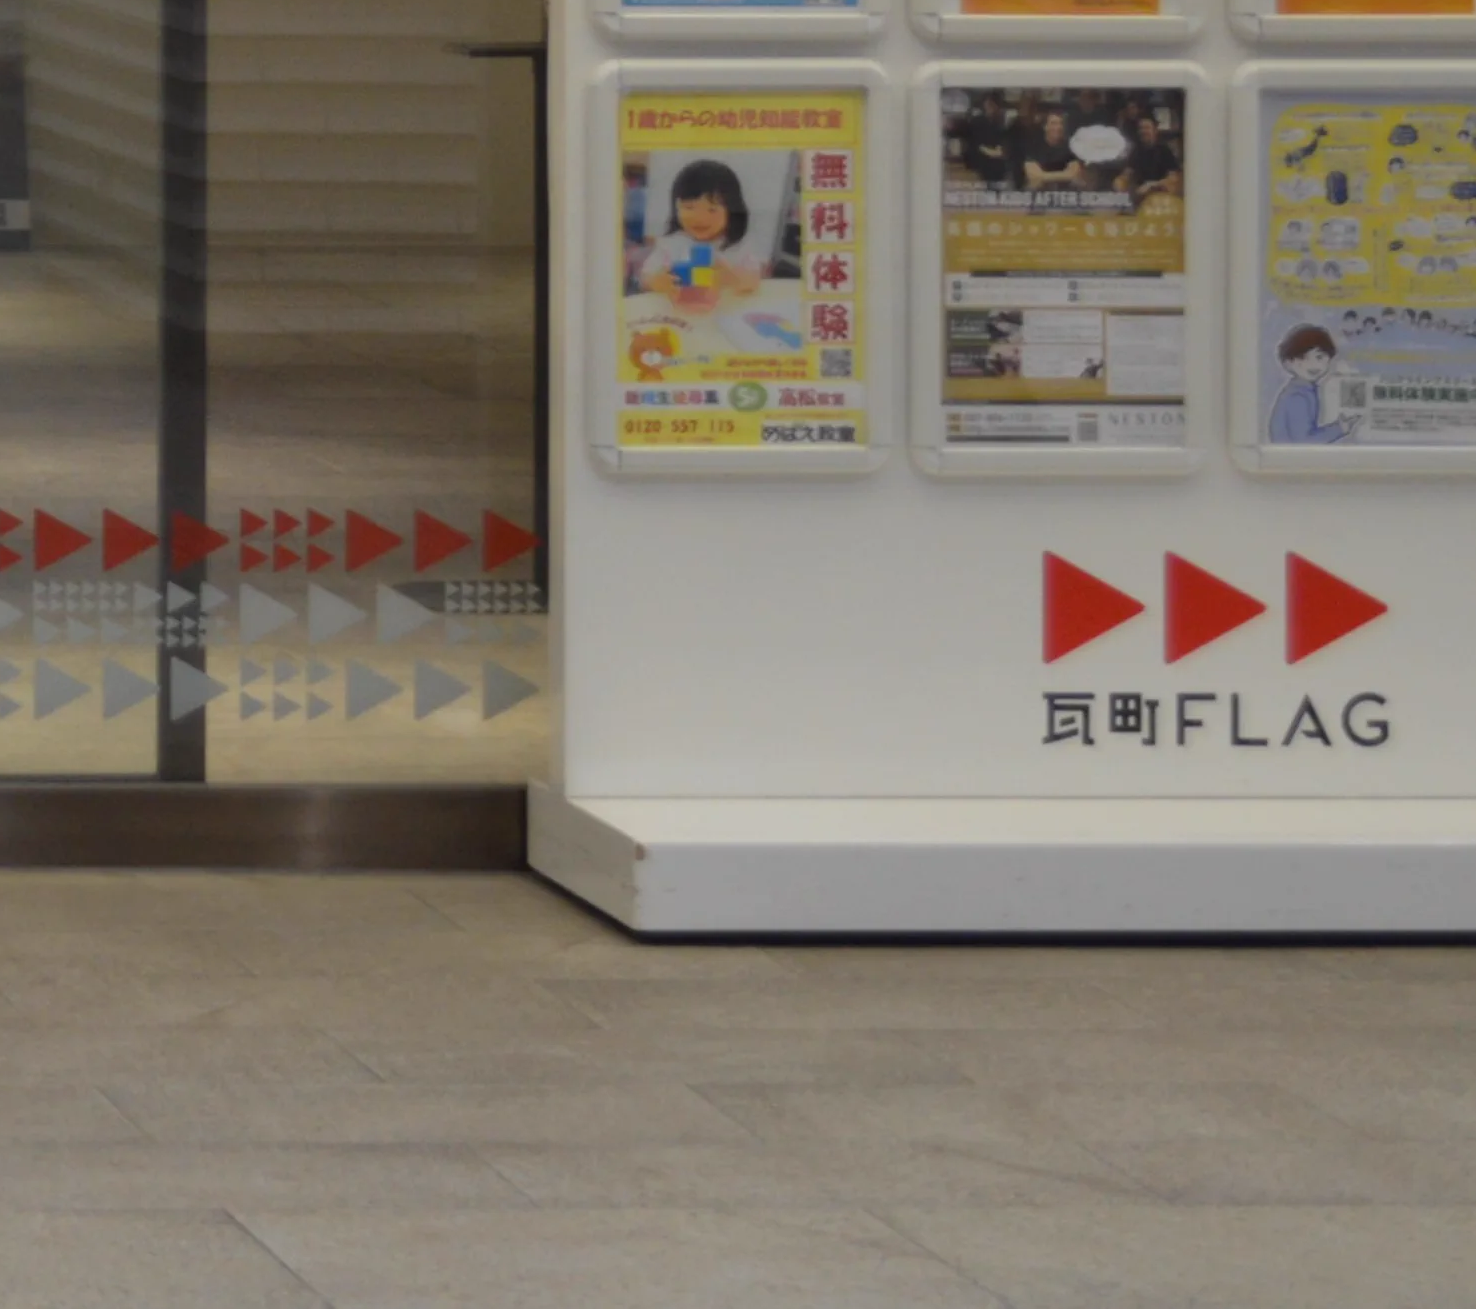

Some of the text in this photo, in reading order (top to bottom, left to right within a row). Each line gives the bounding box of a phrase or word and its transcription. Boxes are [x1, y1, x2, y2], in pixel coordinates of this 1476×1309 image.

[810, 152, 849, 340] 無料体験
[1040, 691, 1393, 750] 瓦町FLAG
